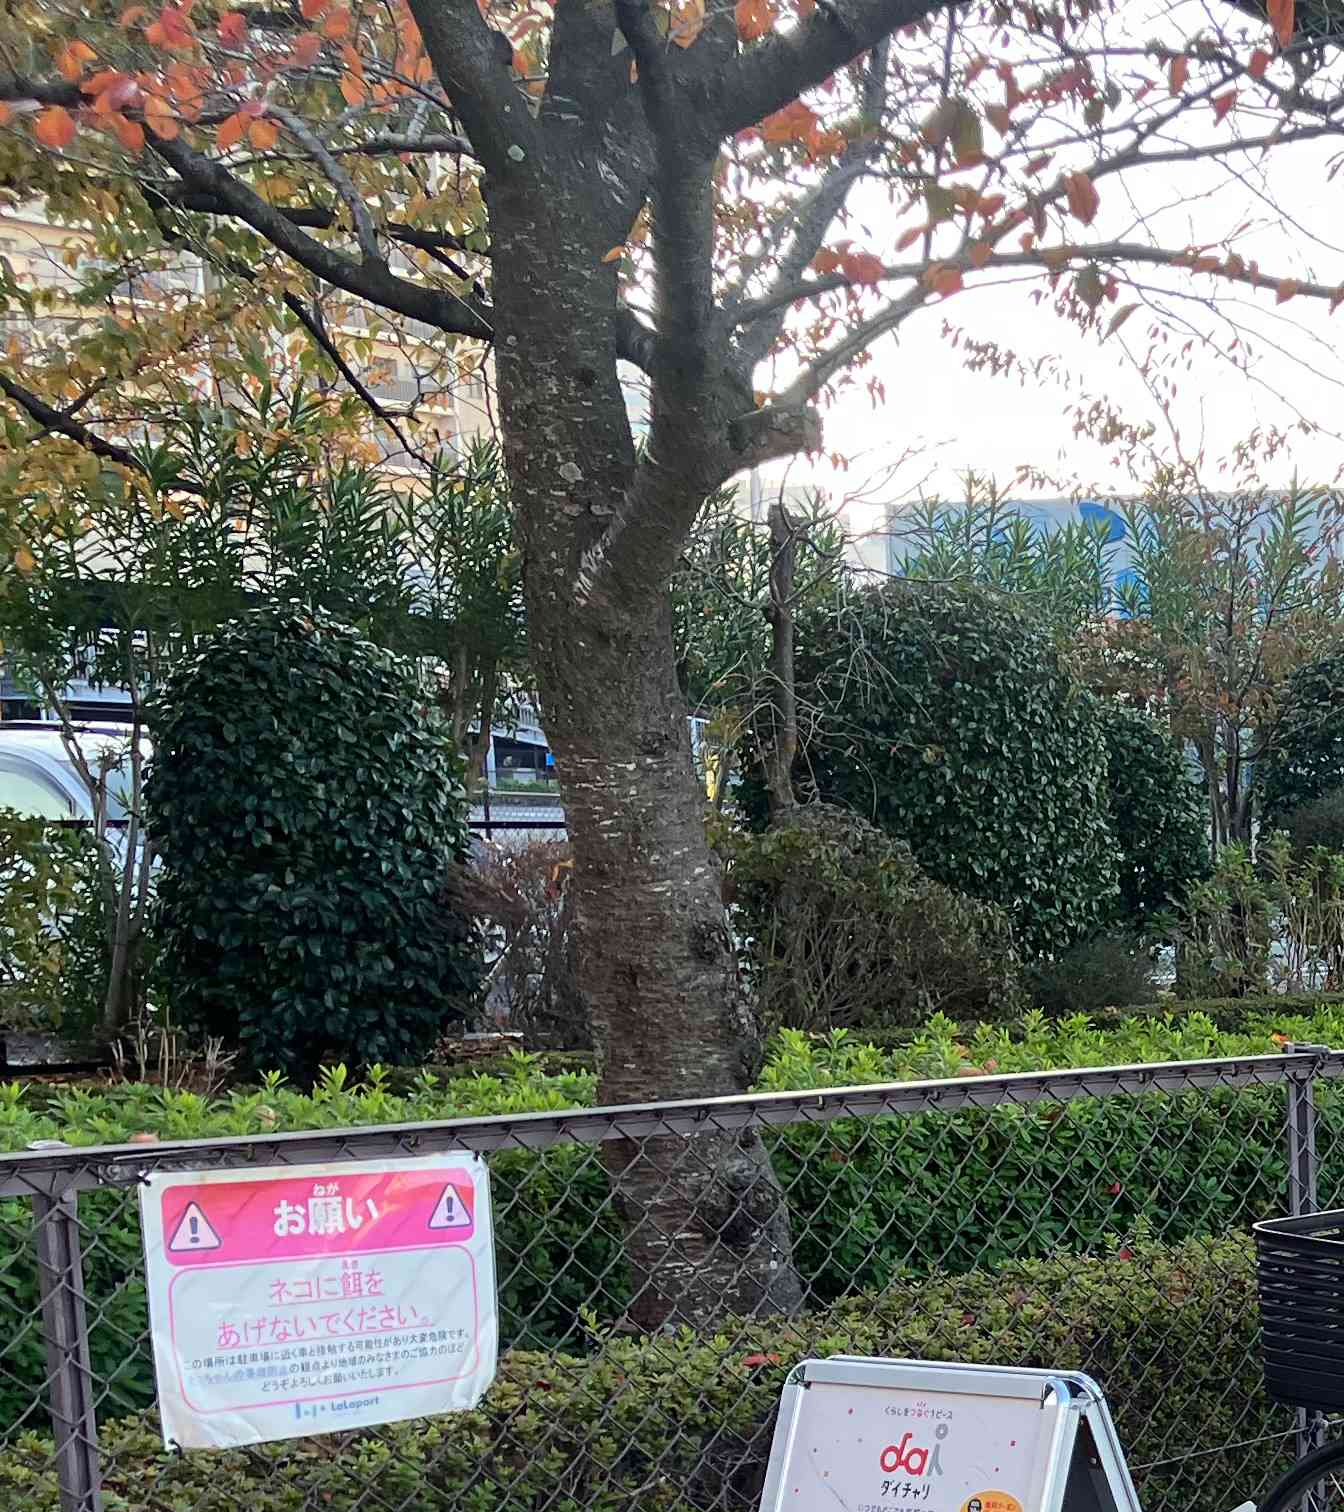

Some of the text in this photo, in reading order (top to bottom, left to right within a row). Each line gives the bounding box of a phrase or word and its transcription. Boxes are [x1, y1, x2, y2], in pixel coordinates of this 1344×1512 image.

[273, 1195, 380, 1237] お願い
[270, 1271, 385, 1302] ネコに餌を
[217, 1304, 431, 1347] あげないでください。
[880, 1480, 931, 1501] ダイチャリ
